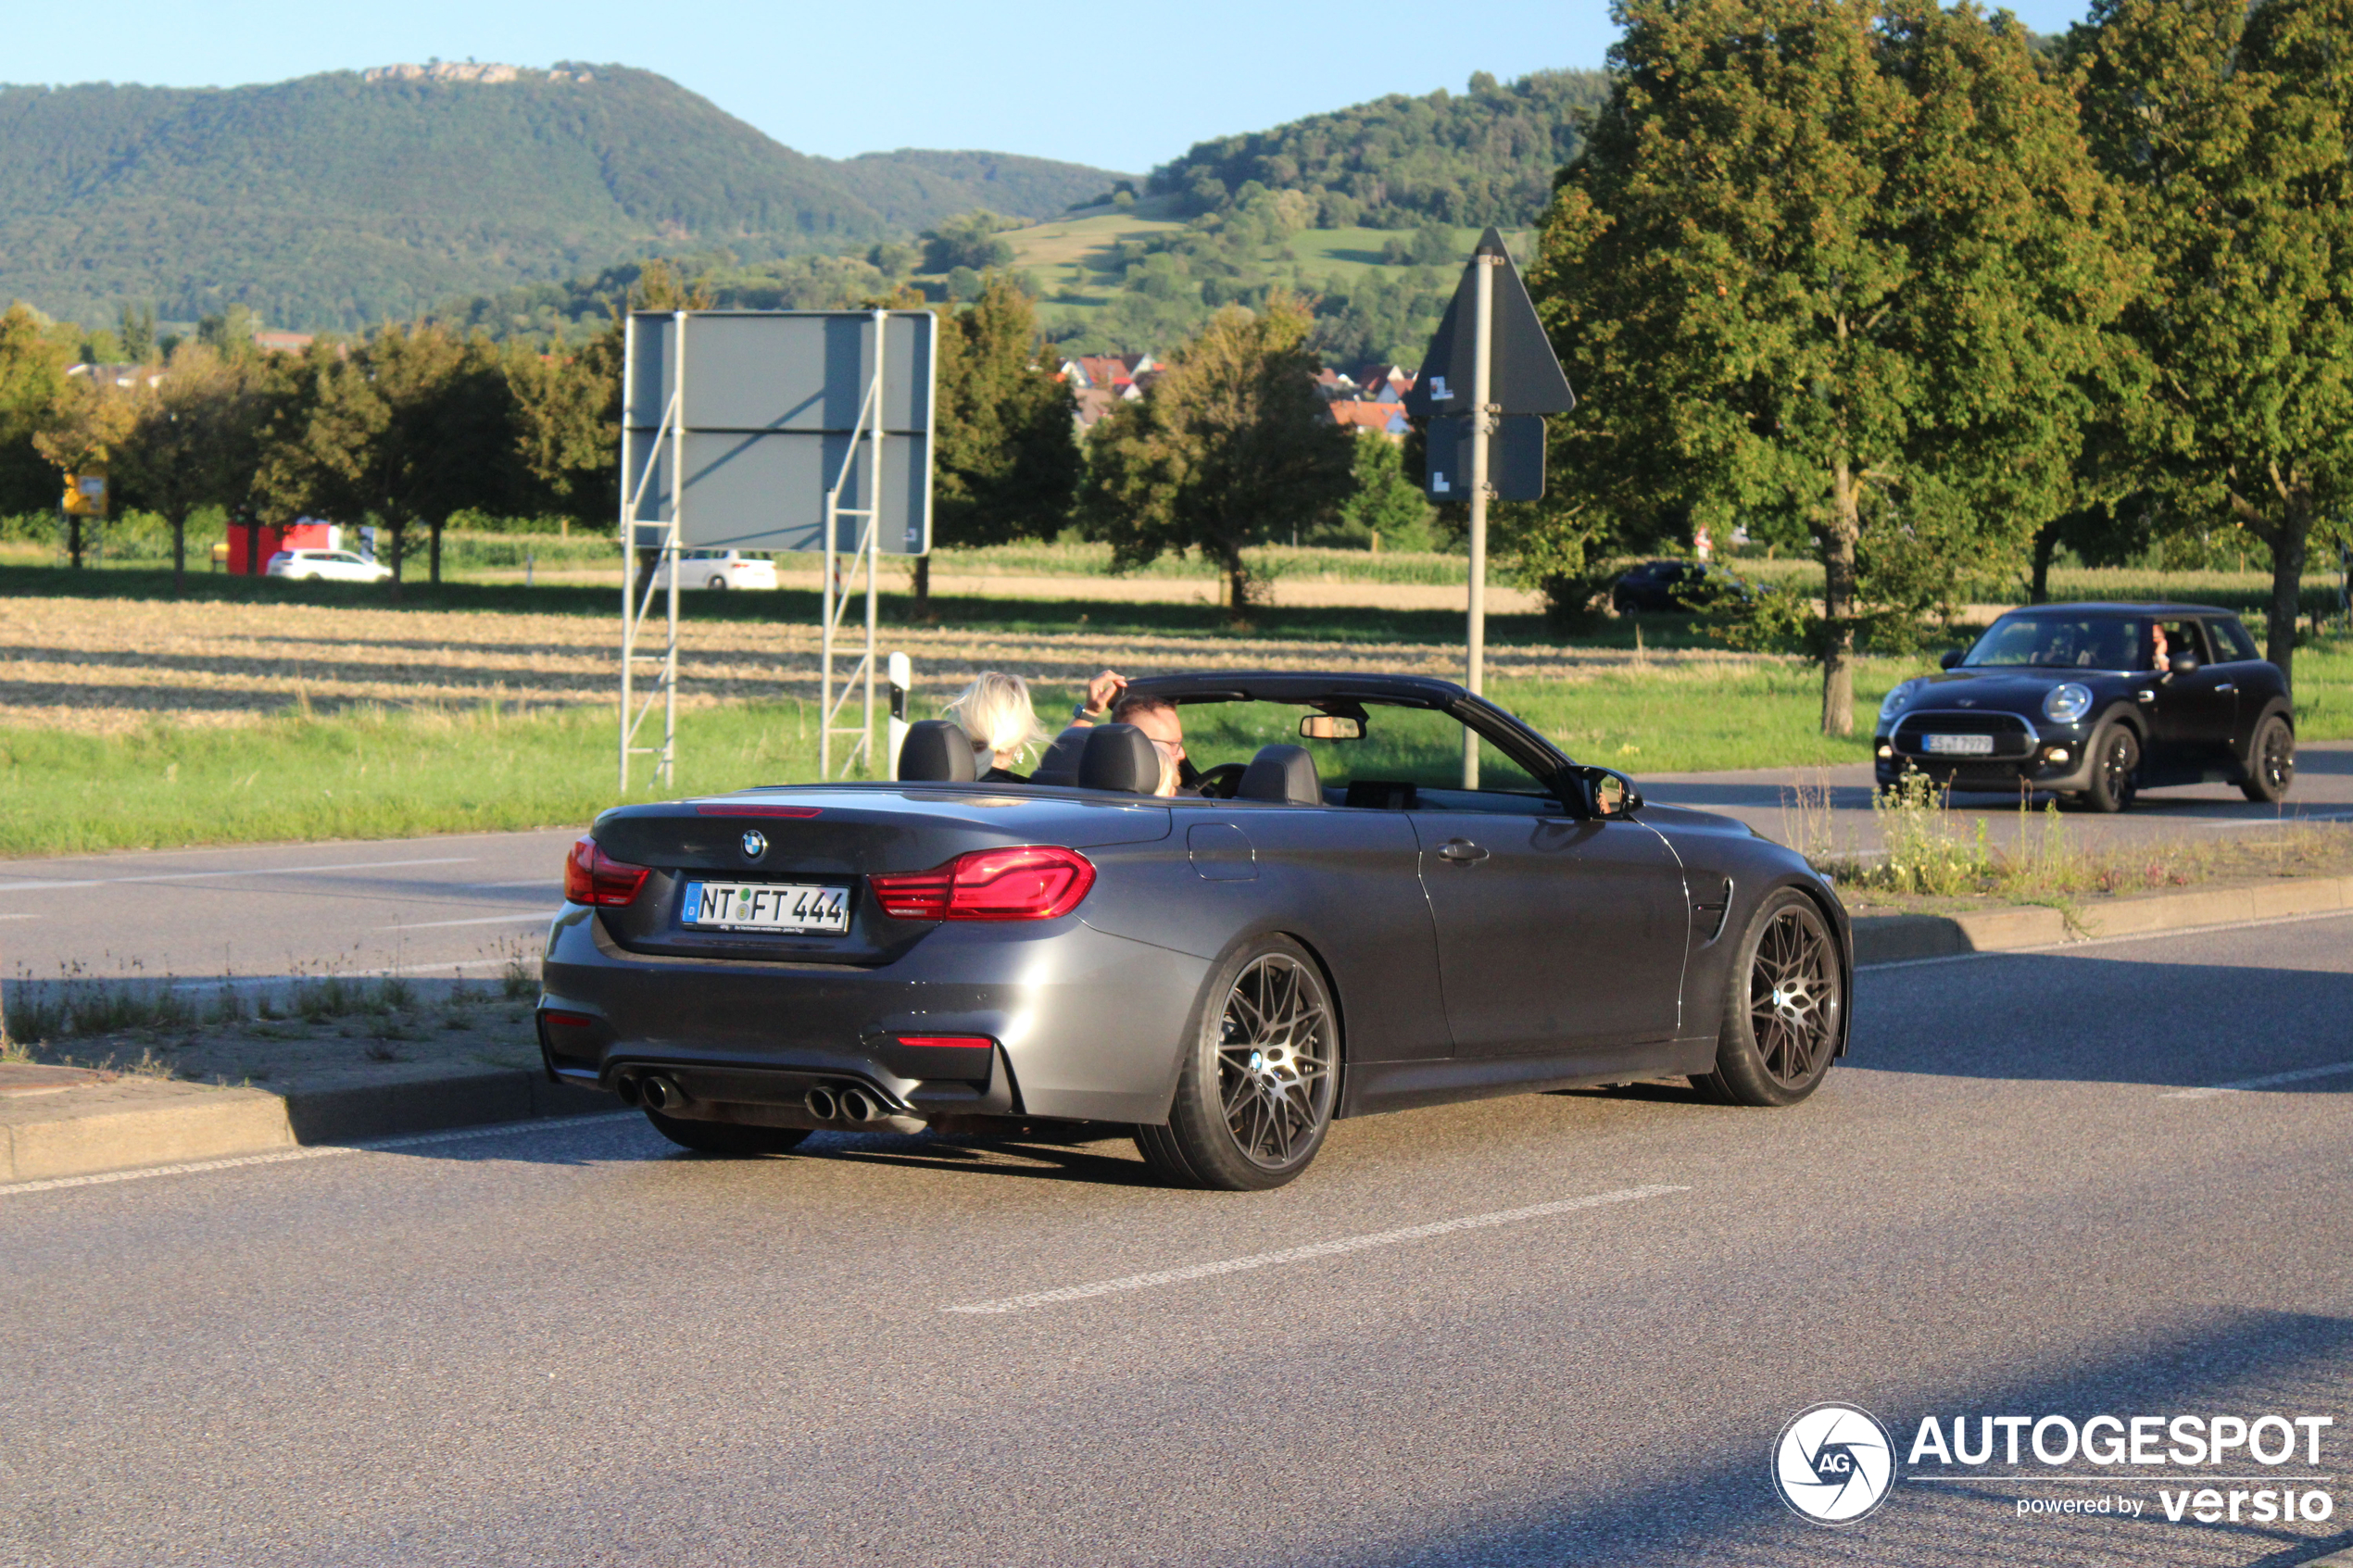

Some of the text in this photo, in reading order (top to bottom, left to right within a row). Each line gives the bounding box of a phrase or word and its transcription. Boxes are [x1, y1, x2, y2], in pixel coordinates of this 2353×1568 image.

[698, 887, 843, 923] NT FT 444
